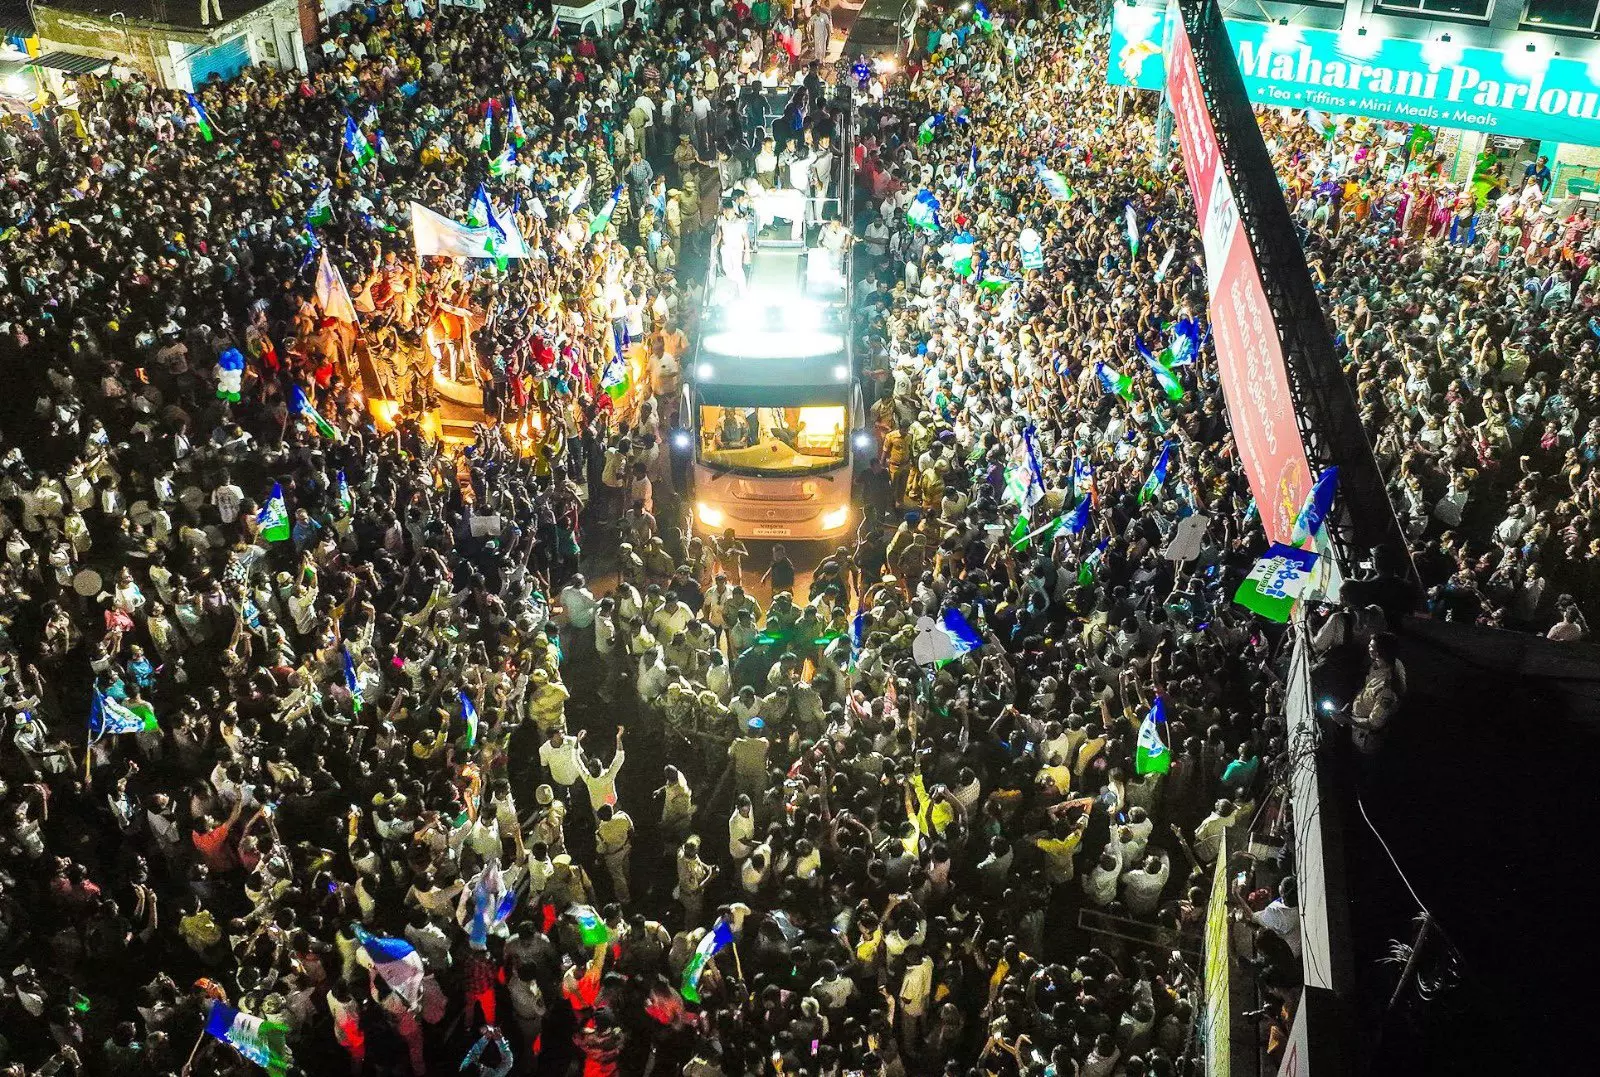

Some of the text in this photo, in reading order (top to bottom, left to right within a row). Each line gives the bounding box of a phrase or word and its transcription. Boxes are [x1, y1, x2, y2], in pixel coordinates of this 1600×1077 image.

[1237, 41, 1439, 99] Maharani
[1448, 63, 1600, 120] Parlou
[1268, 85, 1498, 127] Tea Tiffins Mini Meals Meals
